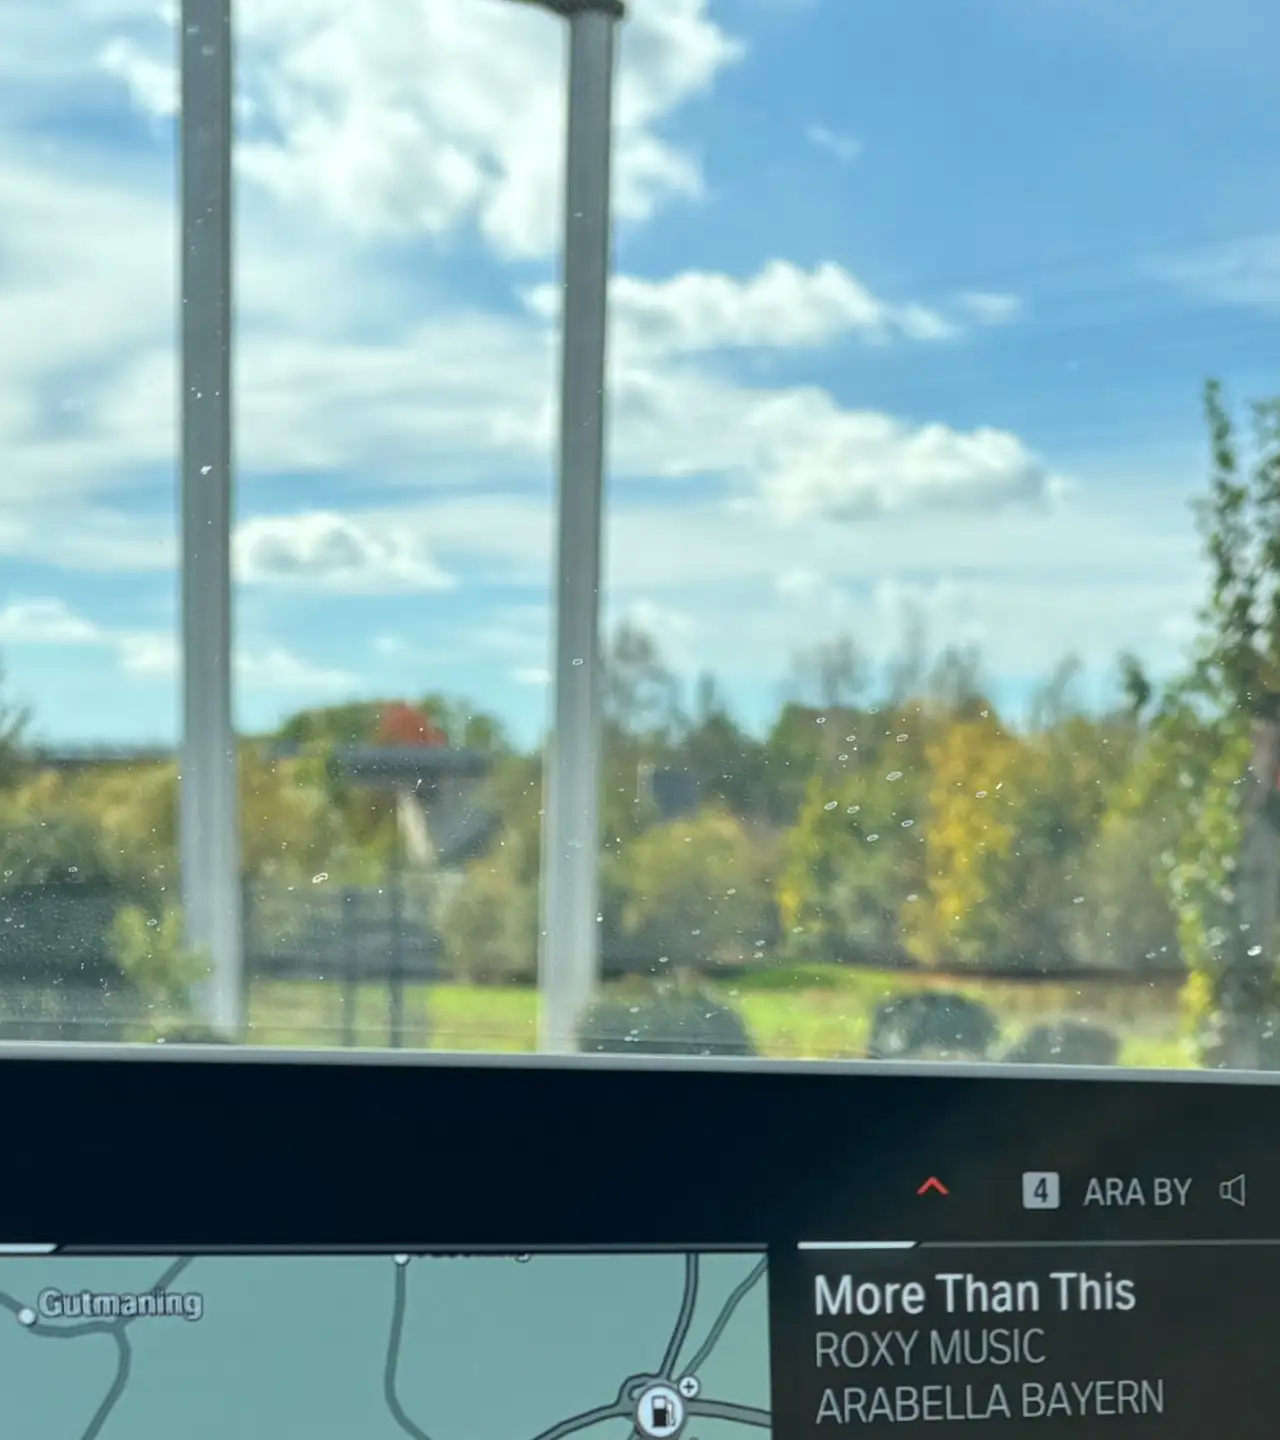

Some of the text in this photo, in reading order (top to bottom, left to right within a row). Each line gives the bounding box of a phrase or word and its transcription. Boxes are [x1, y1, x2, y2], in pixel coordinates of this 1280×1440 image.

[1083, 1179, 1192, 1206] ARA BY
[38, 1289, 204, 1321] Gutmaning
[815, 1271, 1136, 1316] More Than This
[816, 1327, 1047, 1368] ROXY MUSIC
[816, 1379, 1164, 1425] ARABELLA BAYERN
